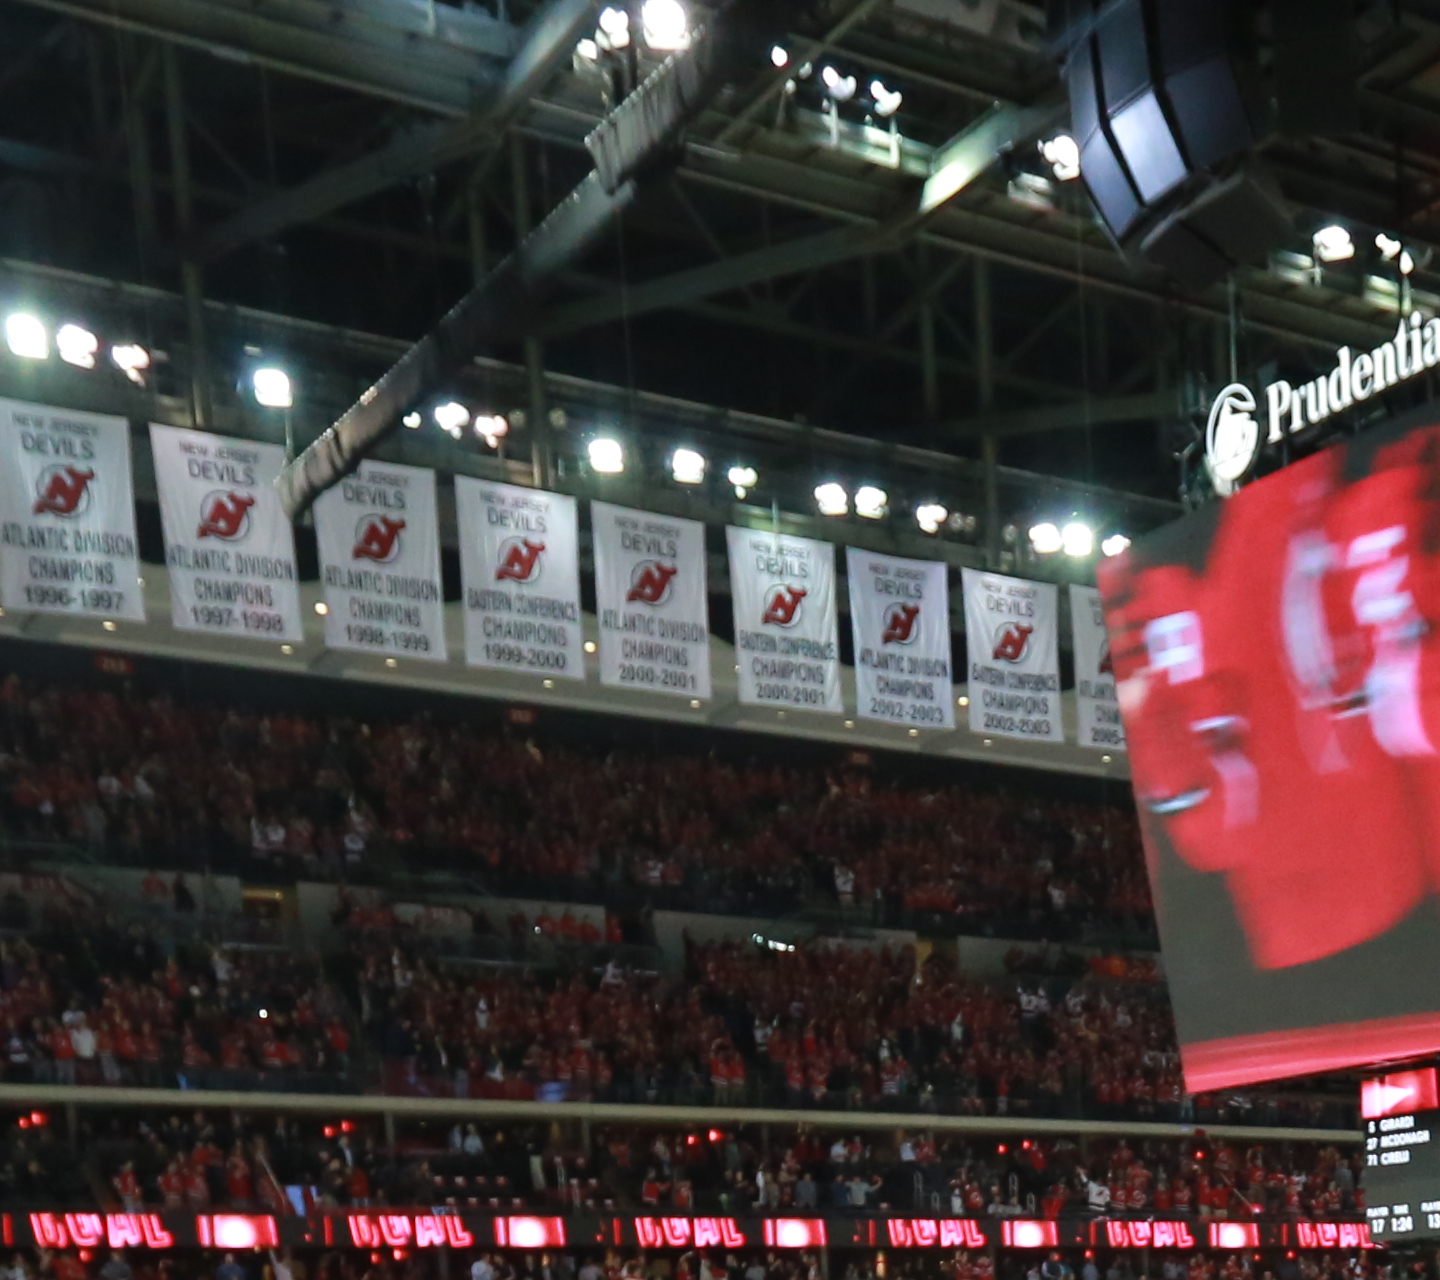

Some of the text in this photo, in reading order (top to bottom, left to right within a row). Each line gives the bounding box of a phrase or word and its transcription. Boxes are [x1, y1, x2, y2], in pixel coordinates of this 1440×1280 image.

[21, 432, 95, 460] DEVILS
[187, 459, 255, 486] DEVILS
[342, 483, 405, 510] DEVILS
[487, 506, 547, 534] DEVILS
[1, 521, 135, 558] ATLANTIC DIVISION
[620, 532, 677, 558] DEVILS
[28, 556, 115, 585] CHAMPIONS
[169, 544, 296, 581] ATLANTIC DIVISION
[755, 556, 809, 579] DEVILS
[193, 578, 274, 607] CHAMPIONS
[325, 564, 438, 602] ATLANTIC DIVISION
[874, 578, 924, 600] DEVILS
[190, 604, 284, 632] 1997-1998
[348, 597, 421, 628] CHAMPIONS
[467, 587, 579, 623] EASTERN CONFERENCE
[985, 595, 1035, 618] DEVILS
[345, 624, 430, 651] 1998-1999
[482, 616, 567, 647] CHAMPIONS
[601, 608, 707, 644] ATLANTIC DIVISION
[484, 642, 566, 671] 1999-2000
[620, 638, 688, 667] CHAMPIONS
[739, 629, 836, 661] EASTERN CONFERENCE
[618, 663, 697, 690] 2000-2001
[751, 656, 825, 685] CHAMPIONS
[860, 648, 949, 678] ATLANTIC DIVISION
[875, 675, 934, 700] CHAMPIONS
[870, 697, 944, 723] 2002-2003
[981, 690, 1050, 716] CHAMPIONS
[983, 712, 1051, 736] 2002-2003
[1379, 1115, 1415, 1133] GIRARDI
[1371, 1216, 1414, 1234] 17 1:24
